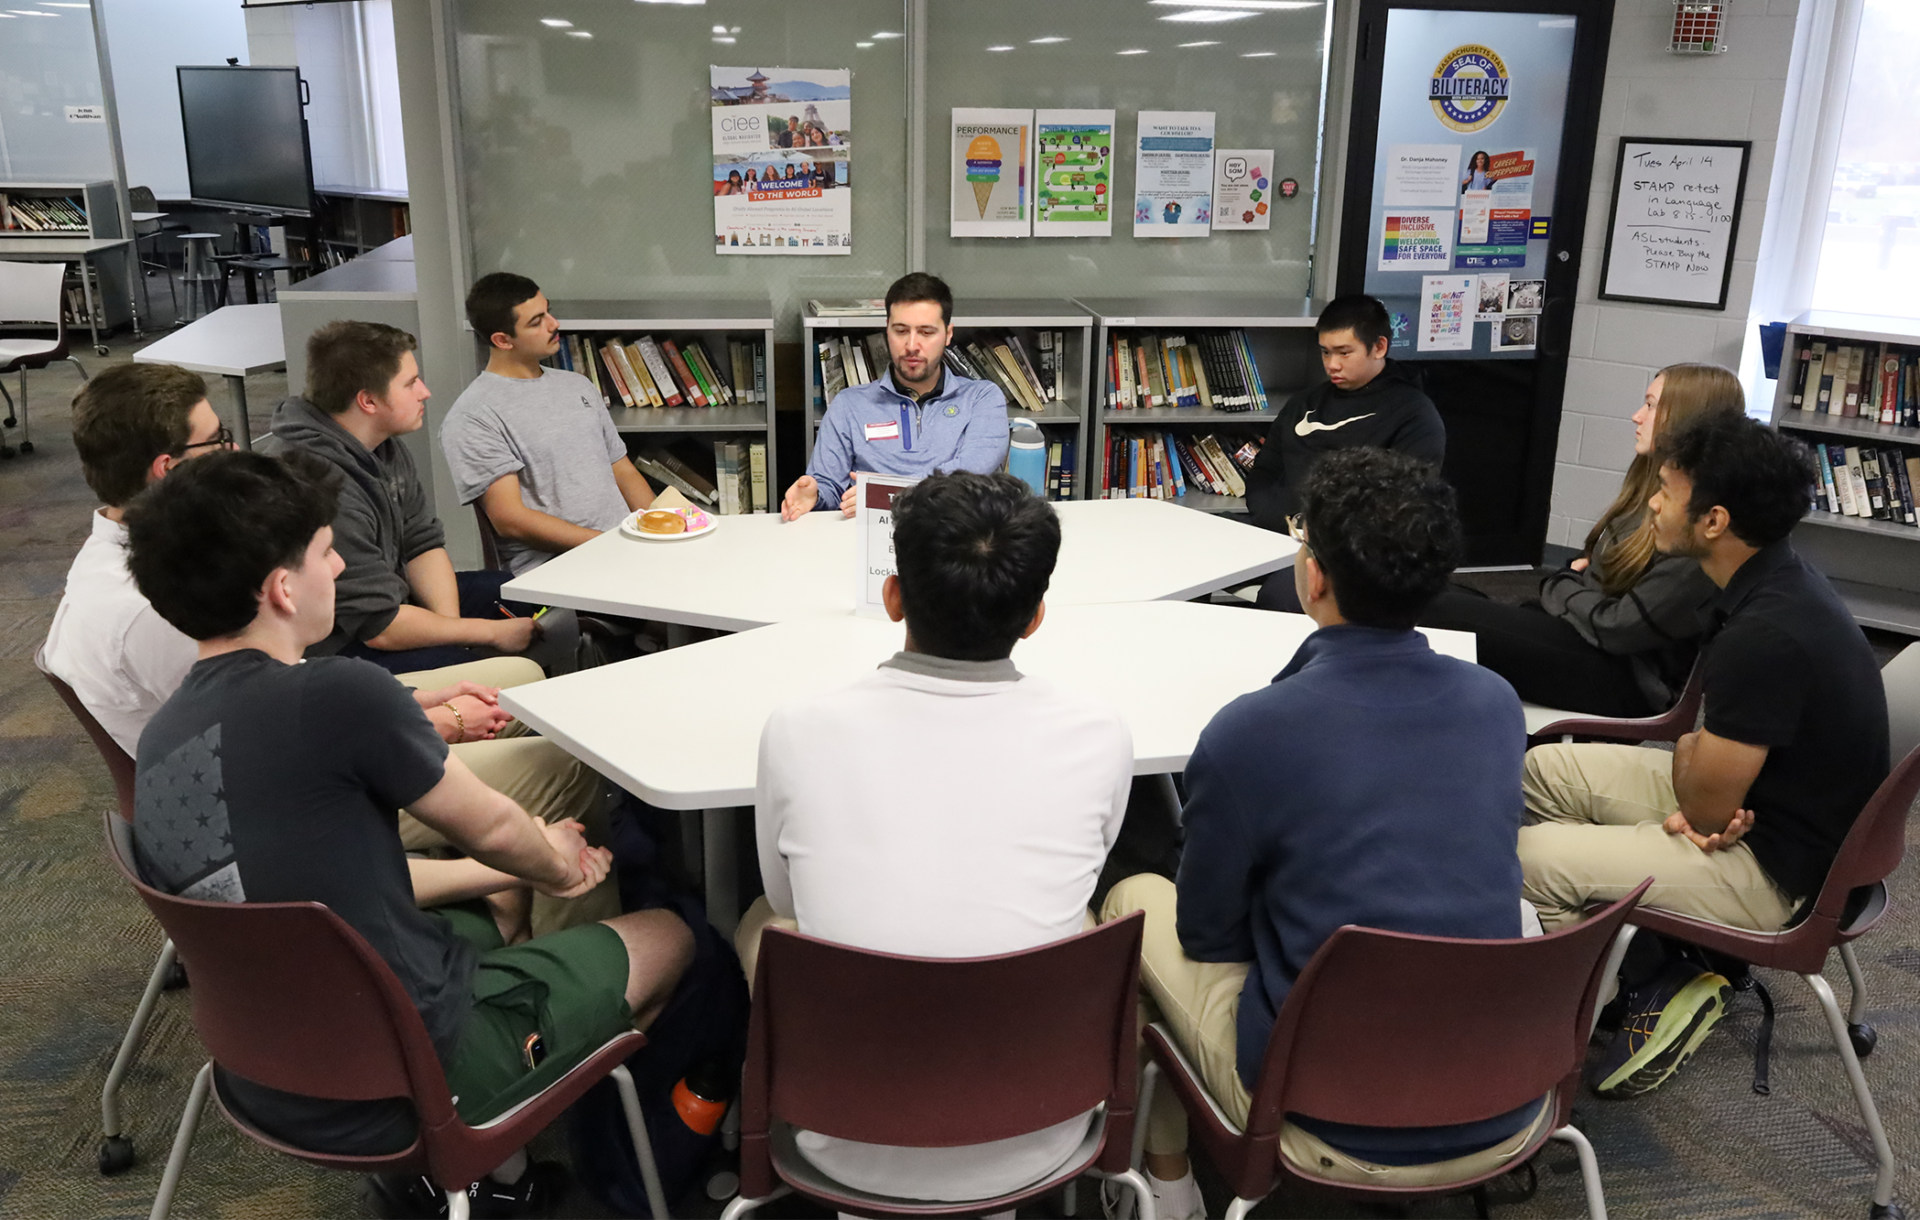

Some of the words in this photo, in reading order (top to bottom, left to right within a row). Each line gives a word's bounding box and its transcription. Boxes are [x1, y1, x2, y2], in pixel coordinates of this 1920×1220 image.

[1438, 46, 1490, 74] MASSACHUSETTS
[1490, 54, 1506, 74] STATE
[1452, 56, 1477, 70] SEAL
[1479, 58, 1492, 70] OF
[1432, 78, 1508, 95] BILITERACY
[721, 115, 760, 132] ciee
[957, 126, 1018, 135] PERFORMANCE
[1493, 158, 1518, 168] CAREER
[1633, 152, 1662, 168] Tues
[1669, 155, 1693, 170] April
[1701, 156, 1712, 167] 14
[1484, 164, 1531, 178] SUPERPOWER!
[761, 181, 803, 189] WELCOME
[1633, 181, 1675, 192] STAMP
[1648, 208, 1665, 217] Lab
[1665, 198, 1722, 216] Language
[1643, 246, 1674, 256] Please
[1677, 250, 1694, 262] Buy
[1698, 250, 1710, 259] the
[1645, 259, 1680, 271] STAMP
[1686, 264, 1708, 272] Now
[1451, 291, 1465, 300] NOT
[879, 516, 889, 525] AI
